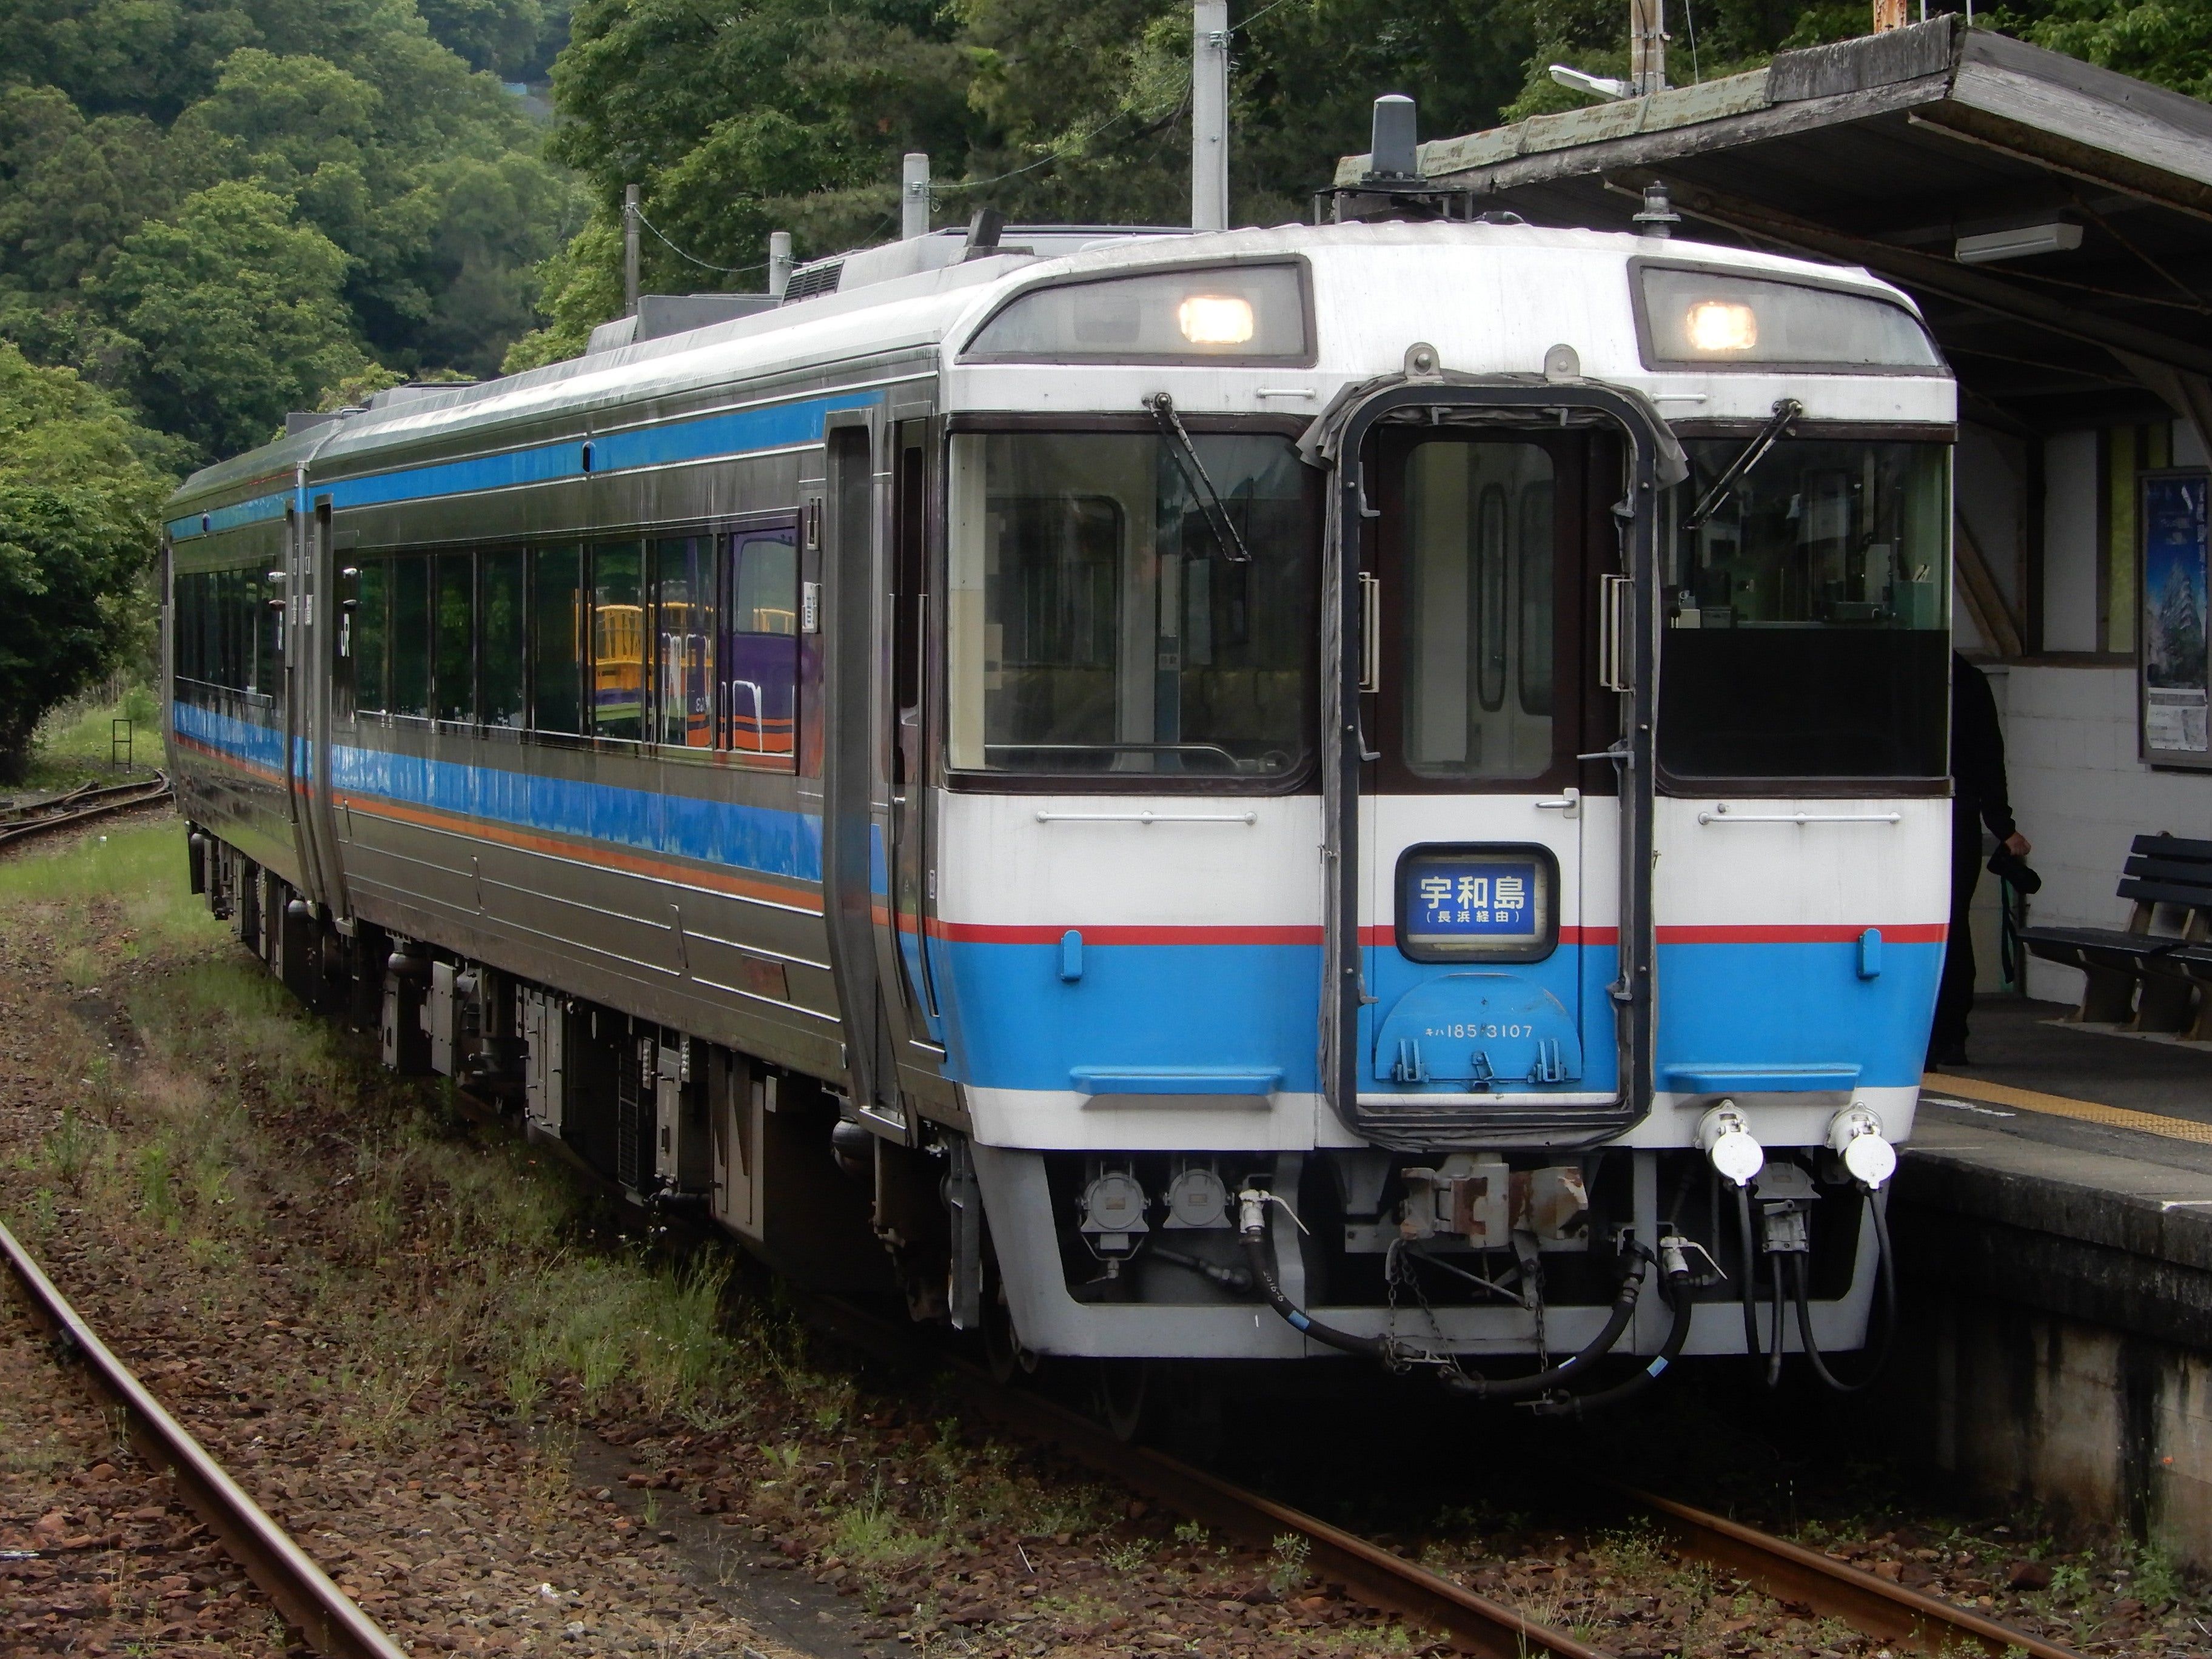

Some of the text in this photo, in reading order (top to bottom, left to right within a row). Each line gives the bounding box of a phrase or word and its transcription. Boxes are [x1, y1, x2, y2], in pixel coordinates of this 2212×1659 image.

[341, 613, 350, 657] JR
[1420, 876, 1526, 910] 宇和島
[1427, 910, 1520, 923] (長浜経由)
[1426, 1024, 1532, 1038] キハ185 3107
